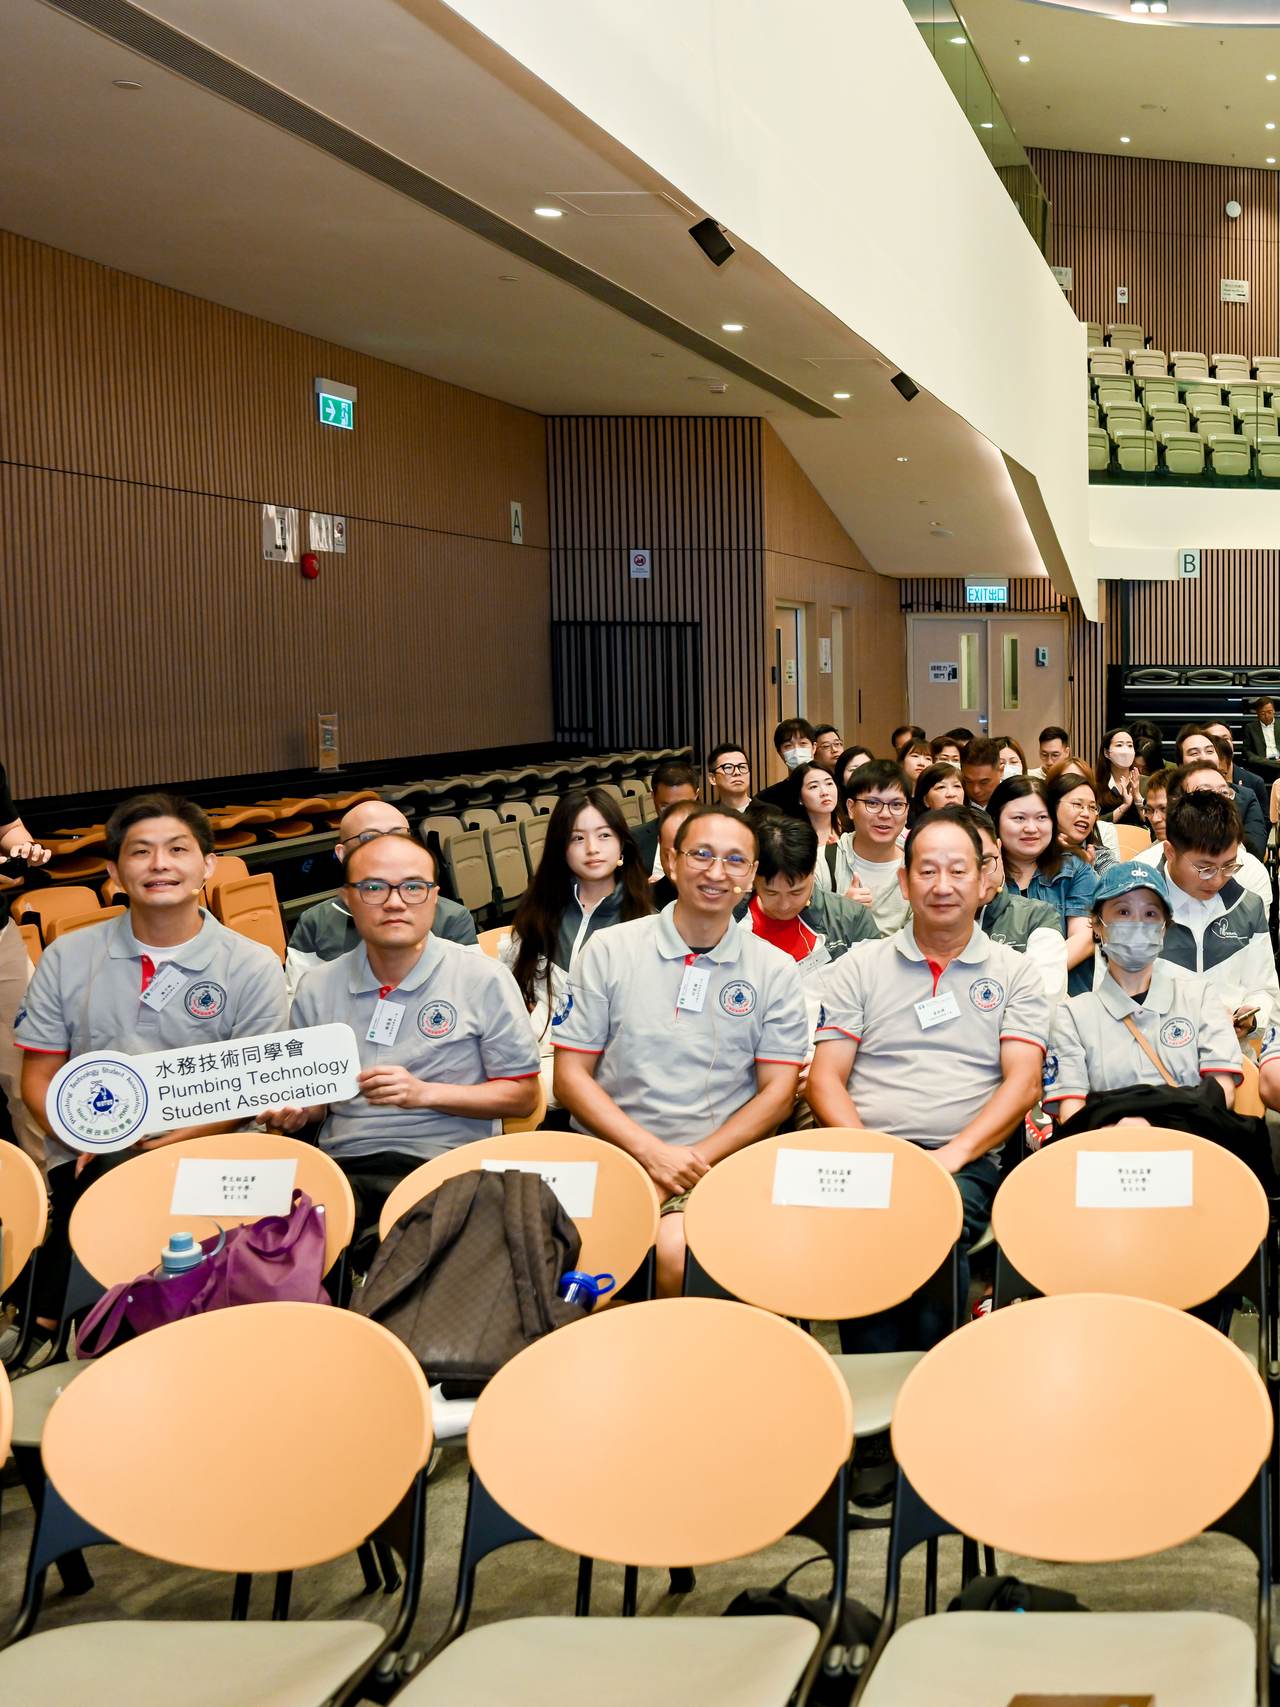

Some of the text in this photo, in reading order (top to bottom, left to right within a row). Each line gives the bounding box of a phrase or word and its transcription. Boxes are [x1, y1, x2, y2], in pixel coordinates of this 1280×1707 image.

[513, 509, 522, 537] A
[1183, 553, 1196, 573] B
[968, 588, 1006, 601] EXIT 出口
[1131, 867, 1149, 878] alo
[155, 1038, 305, 1079] 水務技術同學會
[158, 1058, 349, 1101] Plumbing Technology
[162, 1082, 338, 1121] Student Association
